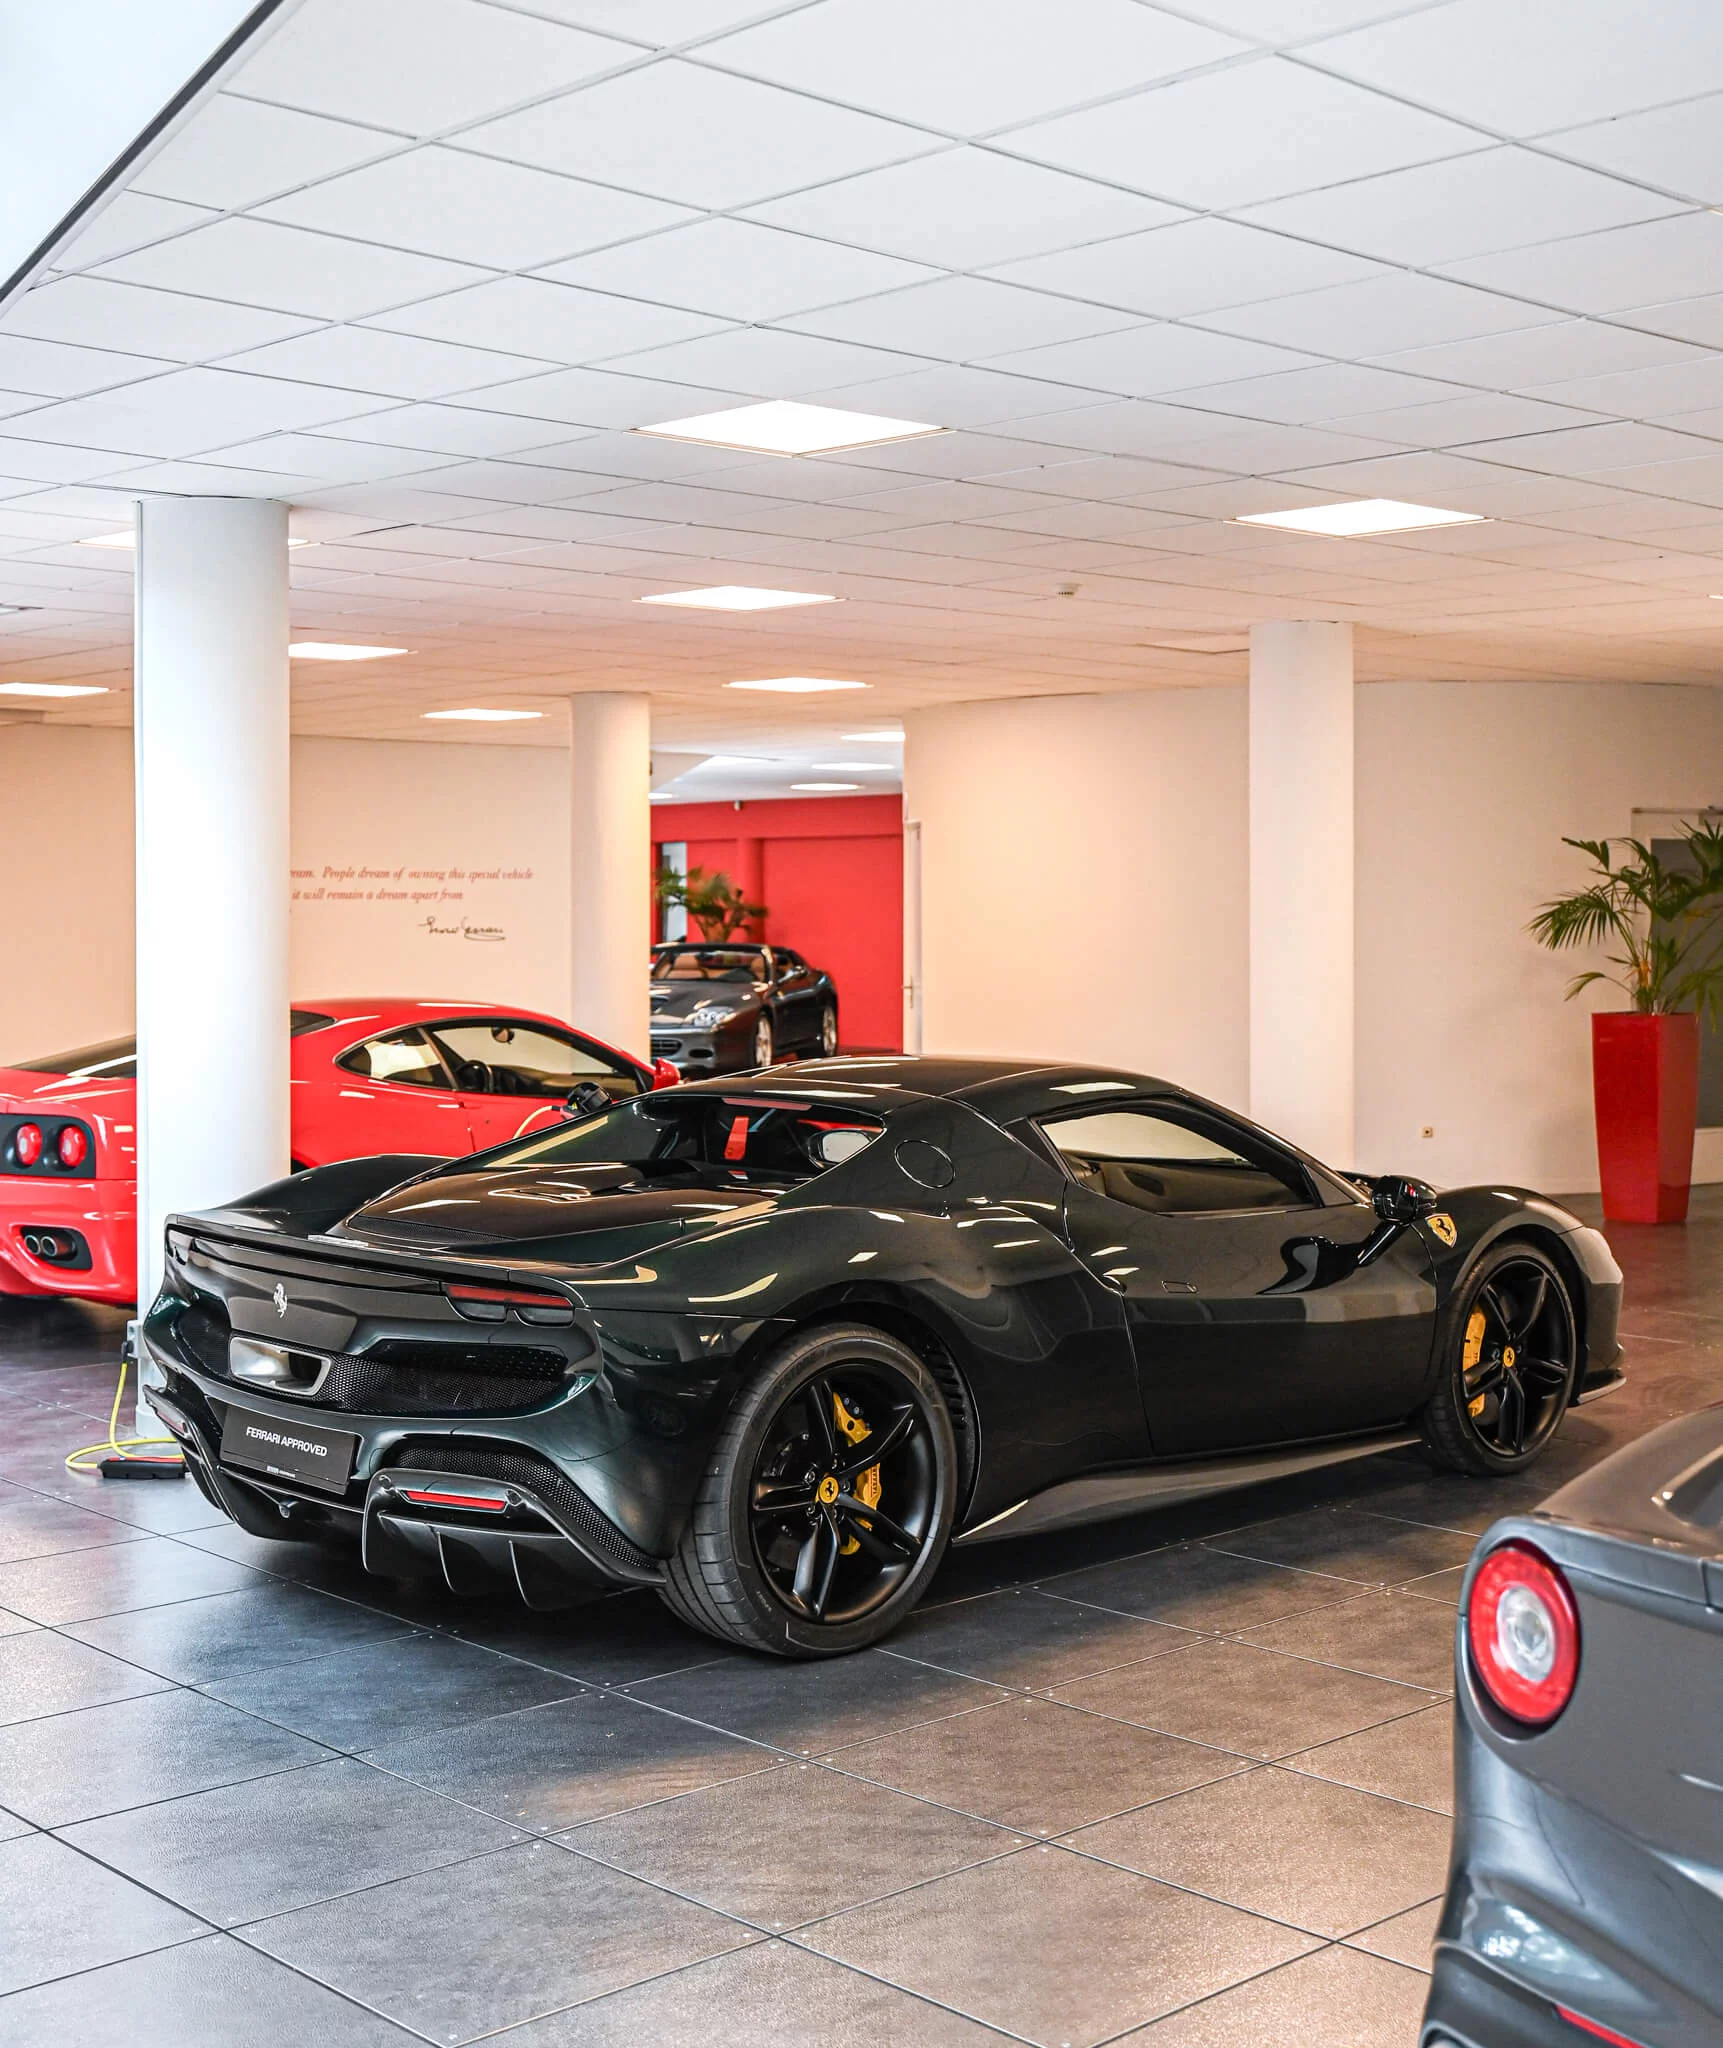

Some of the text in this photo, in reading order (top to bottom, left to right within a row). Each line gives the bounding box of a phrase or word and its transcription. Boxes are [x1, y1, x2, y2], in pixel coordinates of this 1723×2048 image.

[322, 866, 355, 882] People
[358, 866, 390, 878] dream
[393, 866, 405, 881] of
[408, 870, 446, 881] owning
[448, 867, 466, 879] this
[469, 868, 501, 883] special
[502, 868, 533, 879] vehicle
[291, 887, 463, 904] it will remain a dream apart from
[245, 1426, 328, 1457] FERRARI APPROVED
